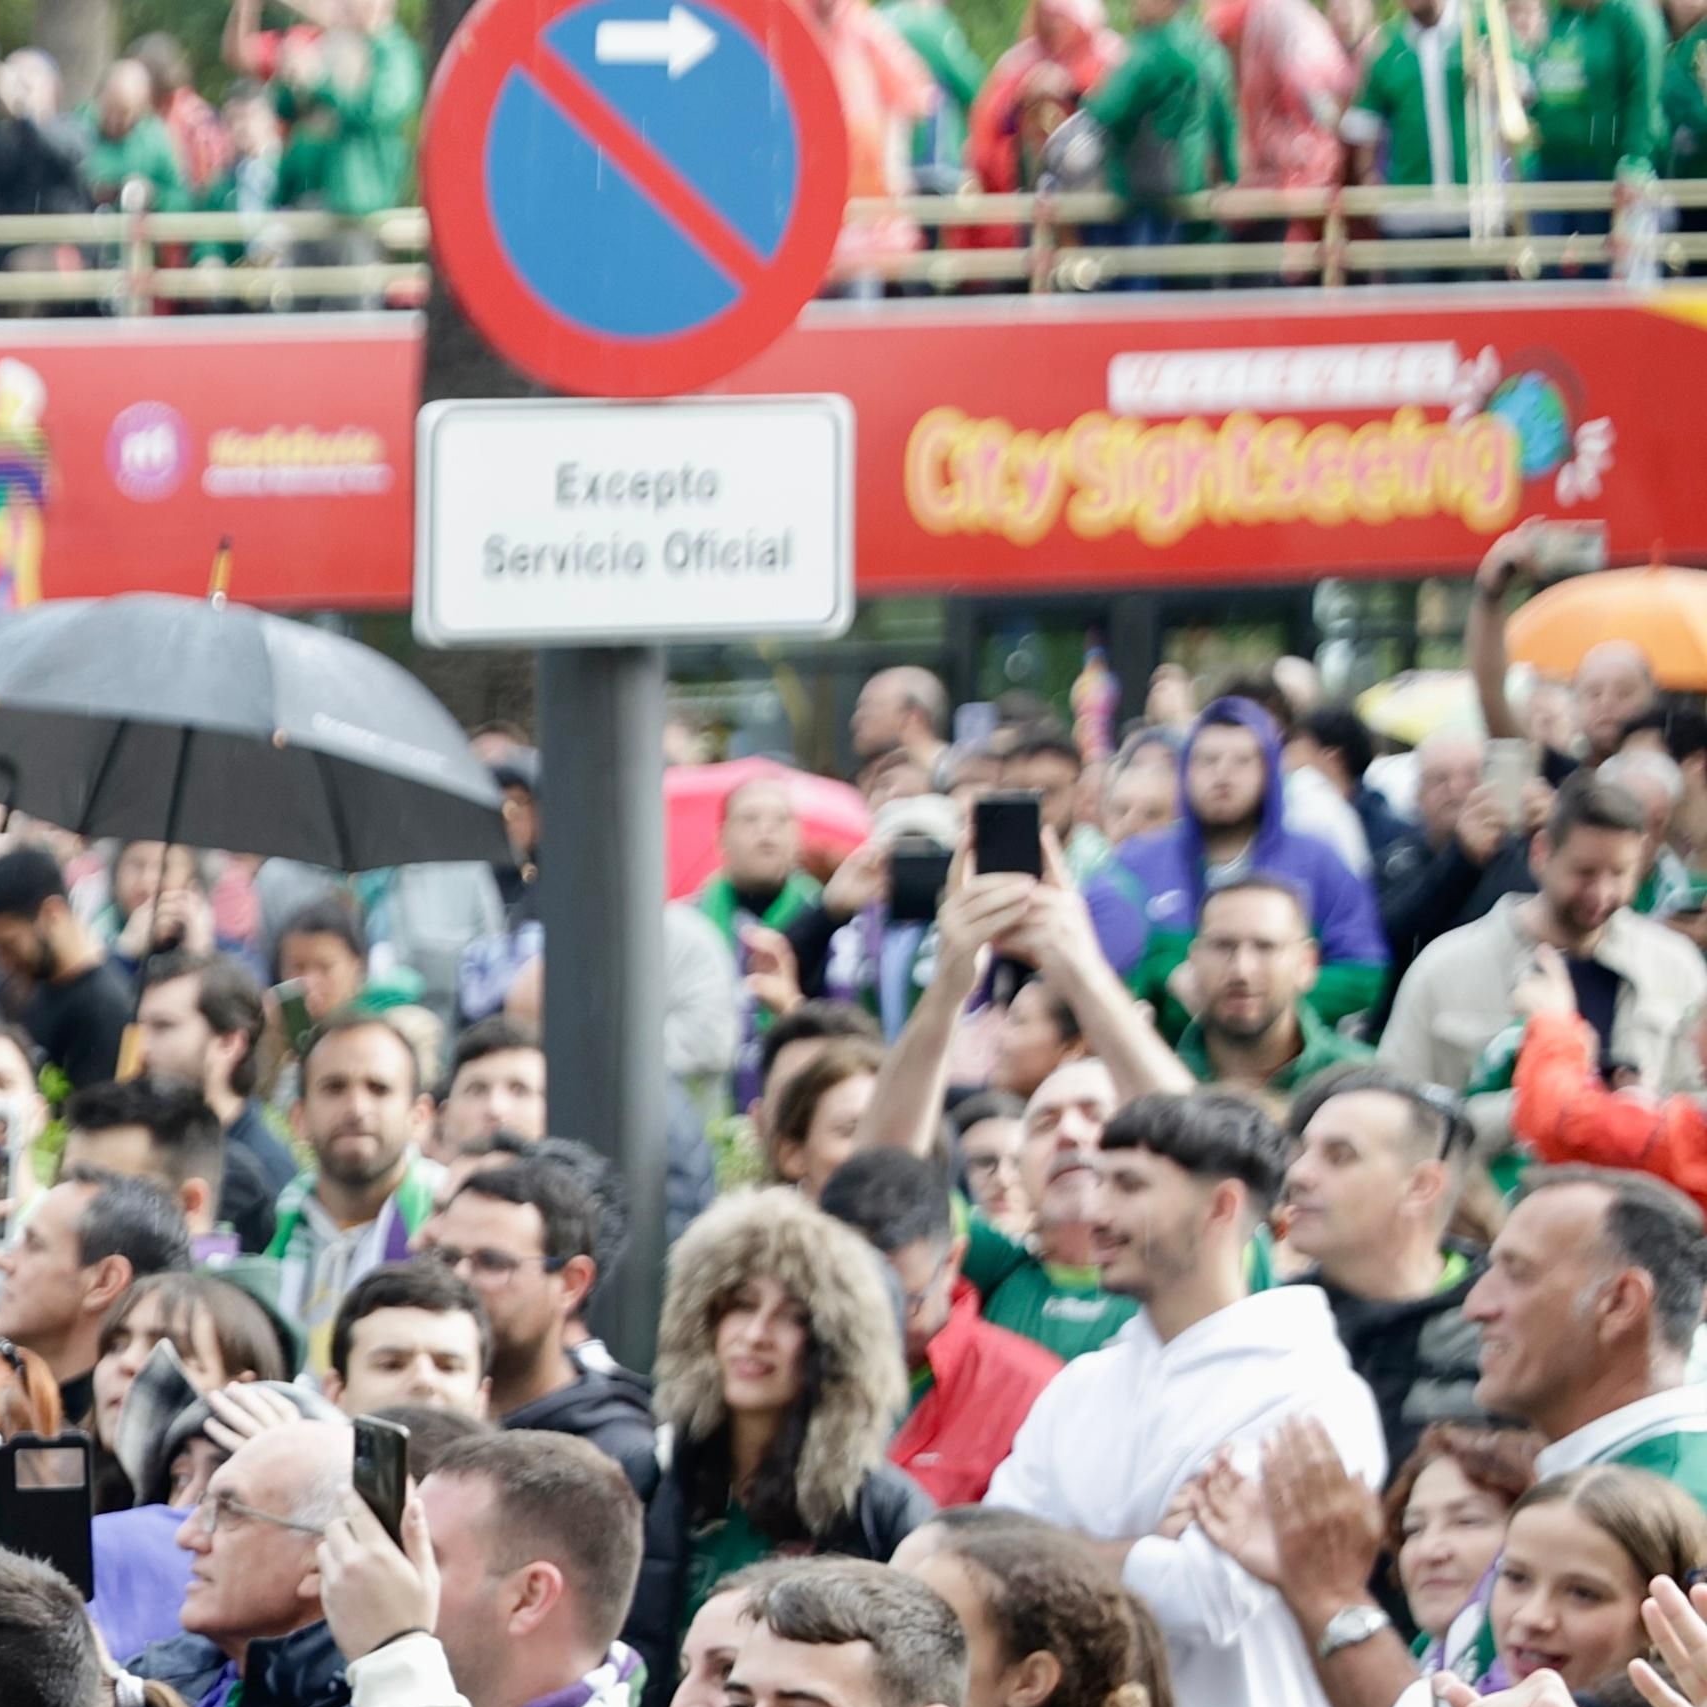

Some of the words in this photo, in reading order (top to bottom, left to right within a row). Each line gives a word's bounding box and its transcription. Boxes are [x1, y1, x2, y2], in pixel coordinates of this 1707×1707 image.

[553, 460, 721, 513] Excepto
[482, 531, 647, 577] Servicio
[662, 526, 794, 571] Oficial
